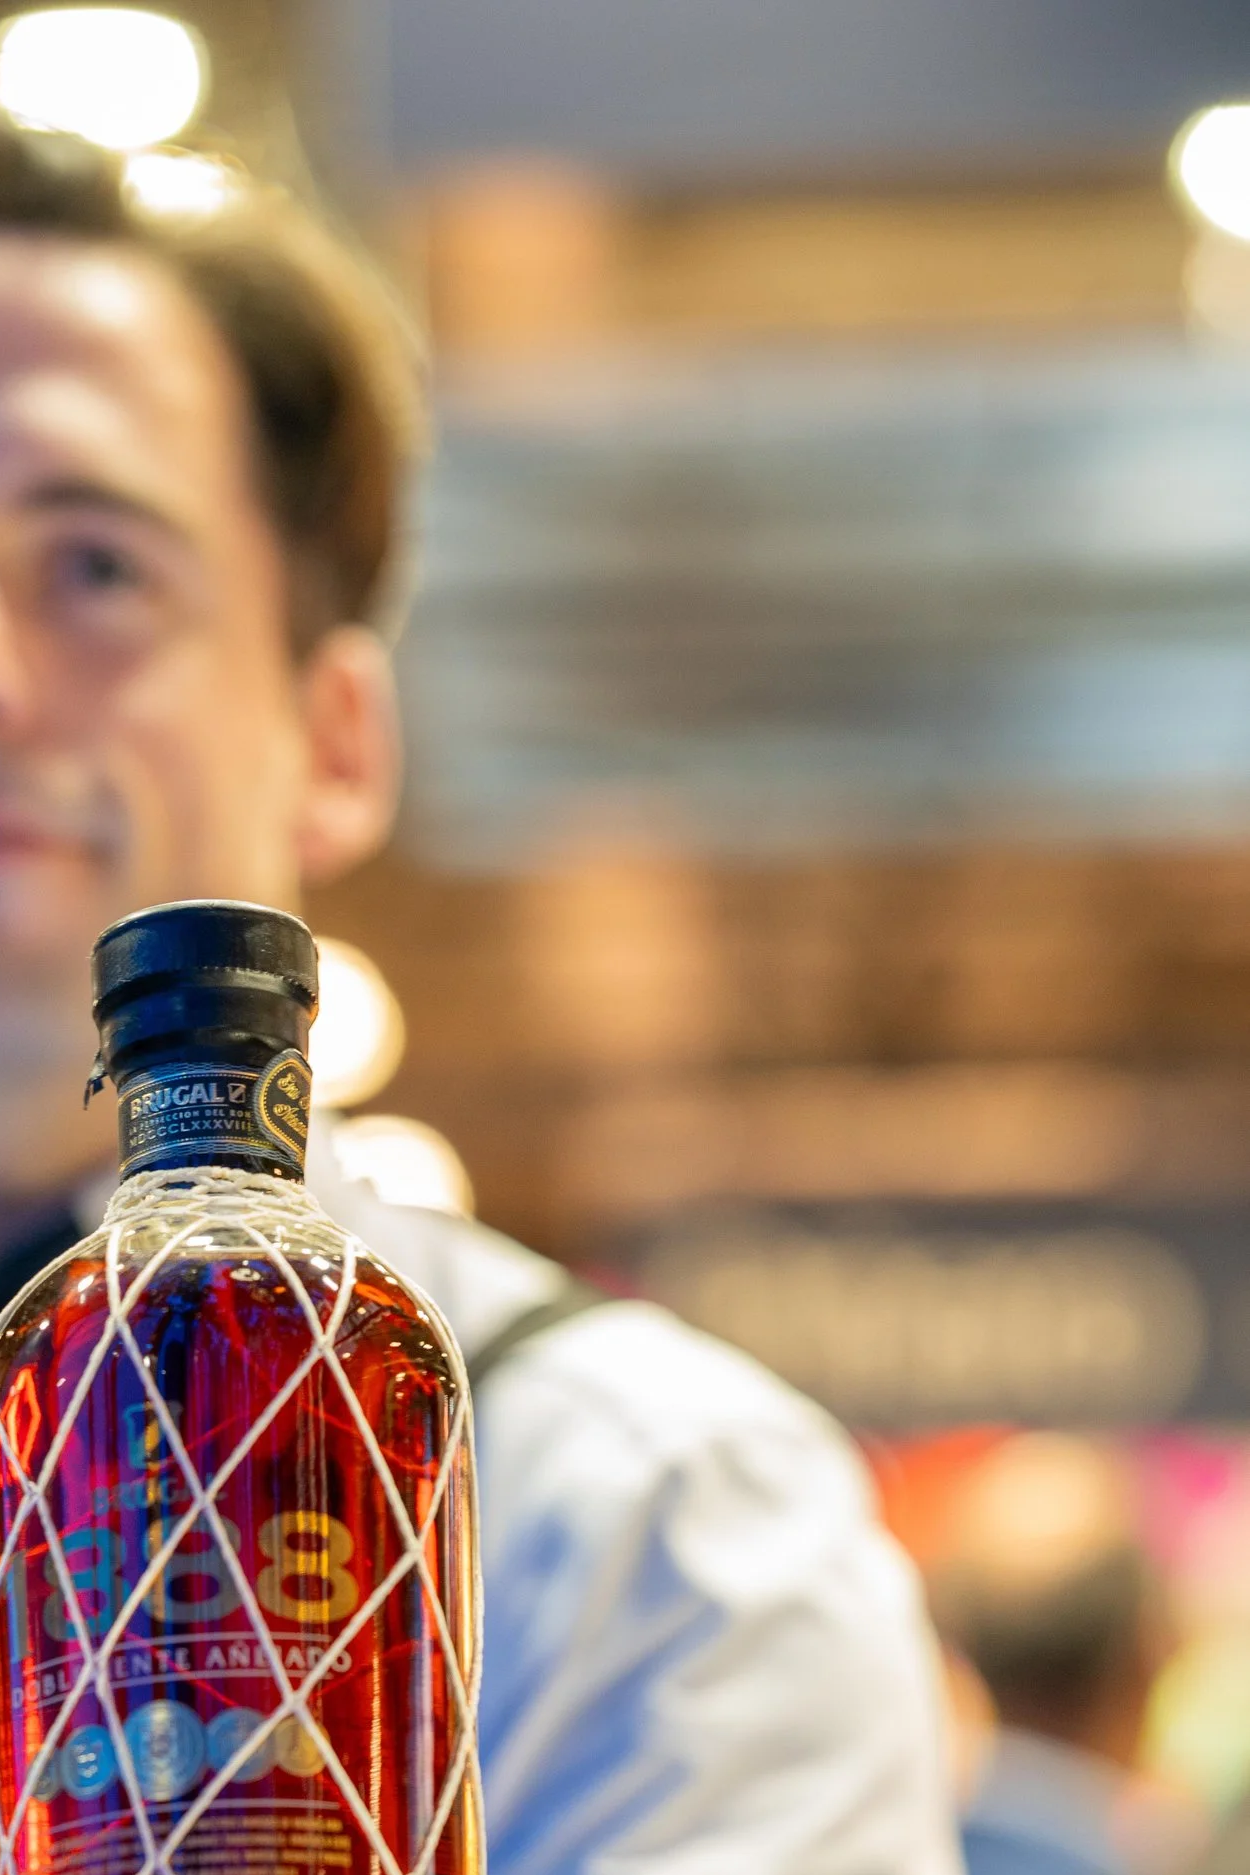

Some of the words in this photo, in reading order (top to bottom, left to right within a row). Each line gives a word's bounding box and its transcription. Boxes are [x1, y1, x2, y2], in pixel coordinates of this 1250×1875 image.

[130, 1082, 225, 1121] BRUGAL
[204, 1108, 225, 1117] DEL
[6, 1510, 359, 1663] 1888
[12, 1647, 191, 1708] DOBLENTE
[205, 1639, 352, 1673] AÑEADO
